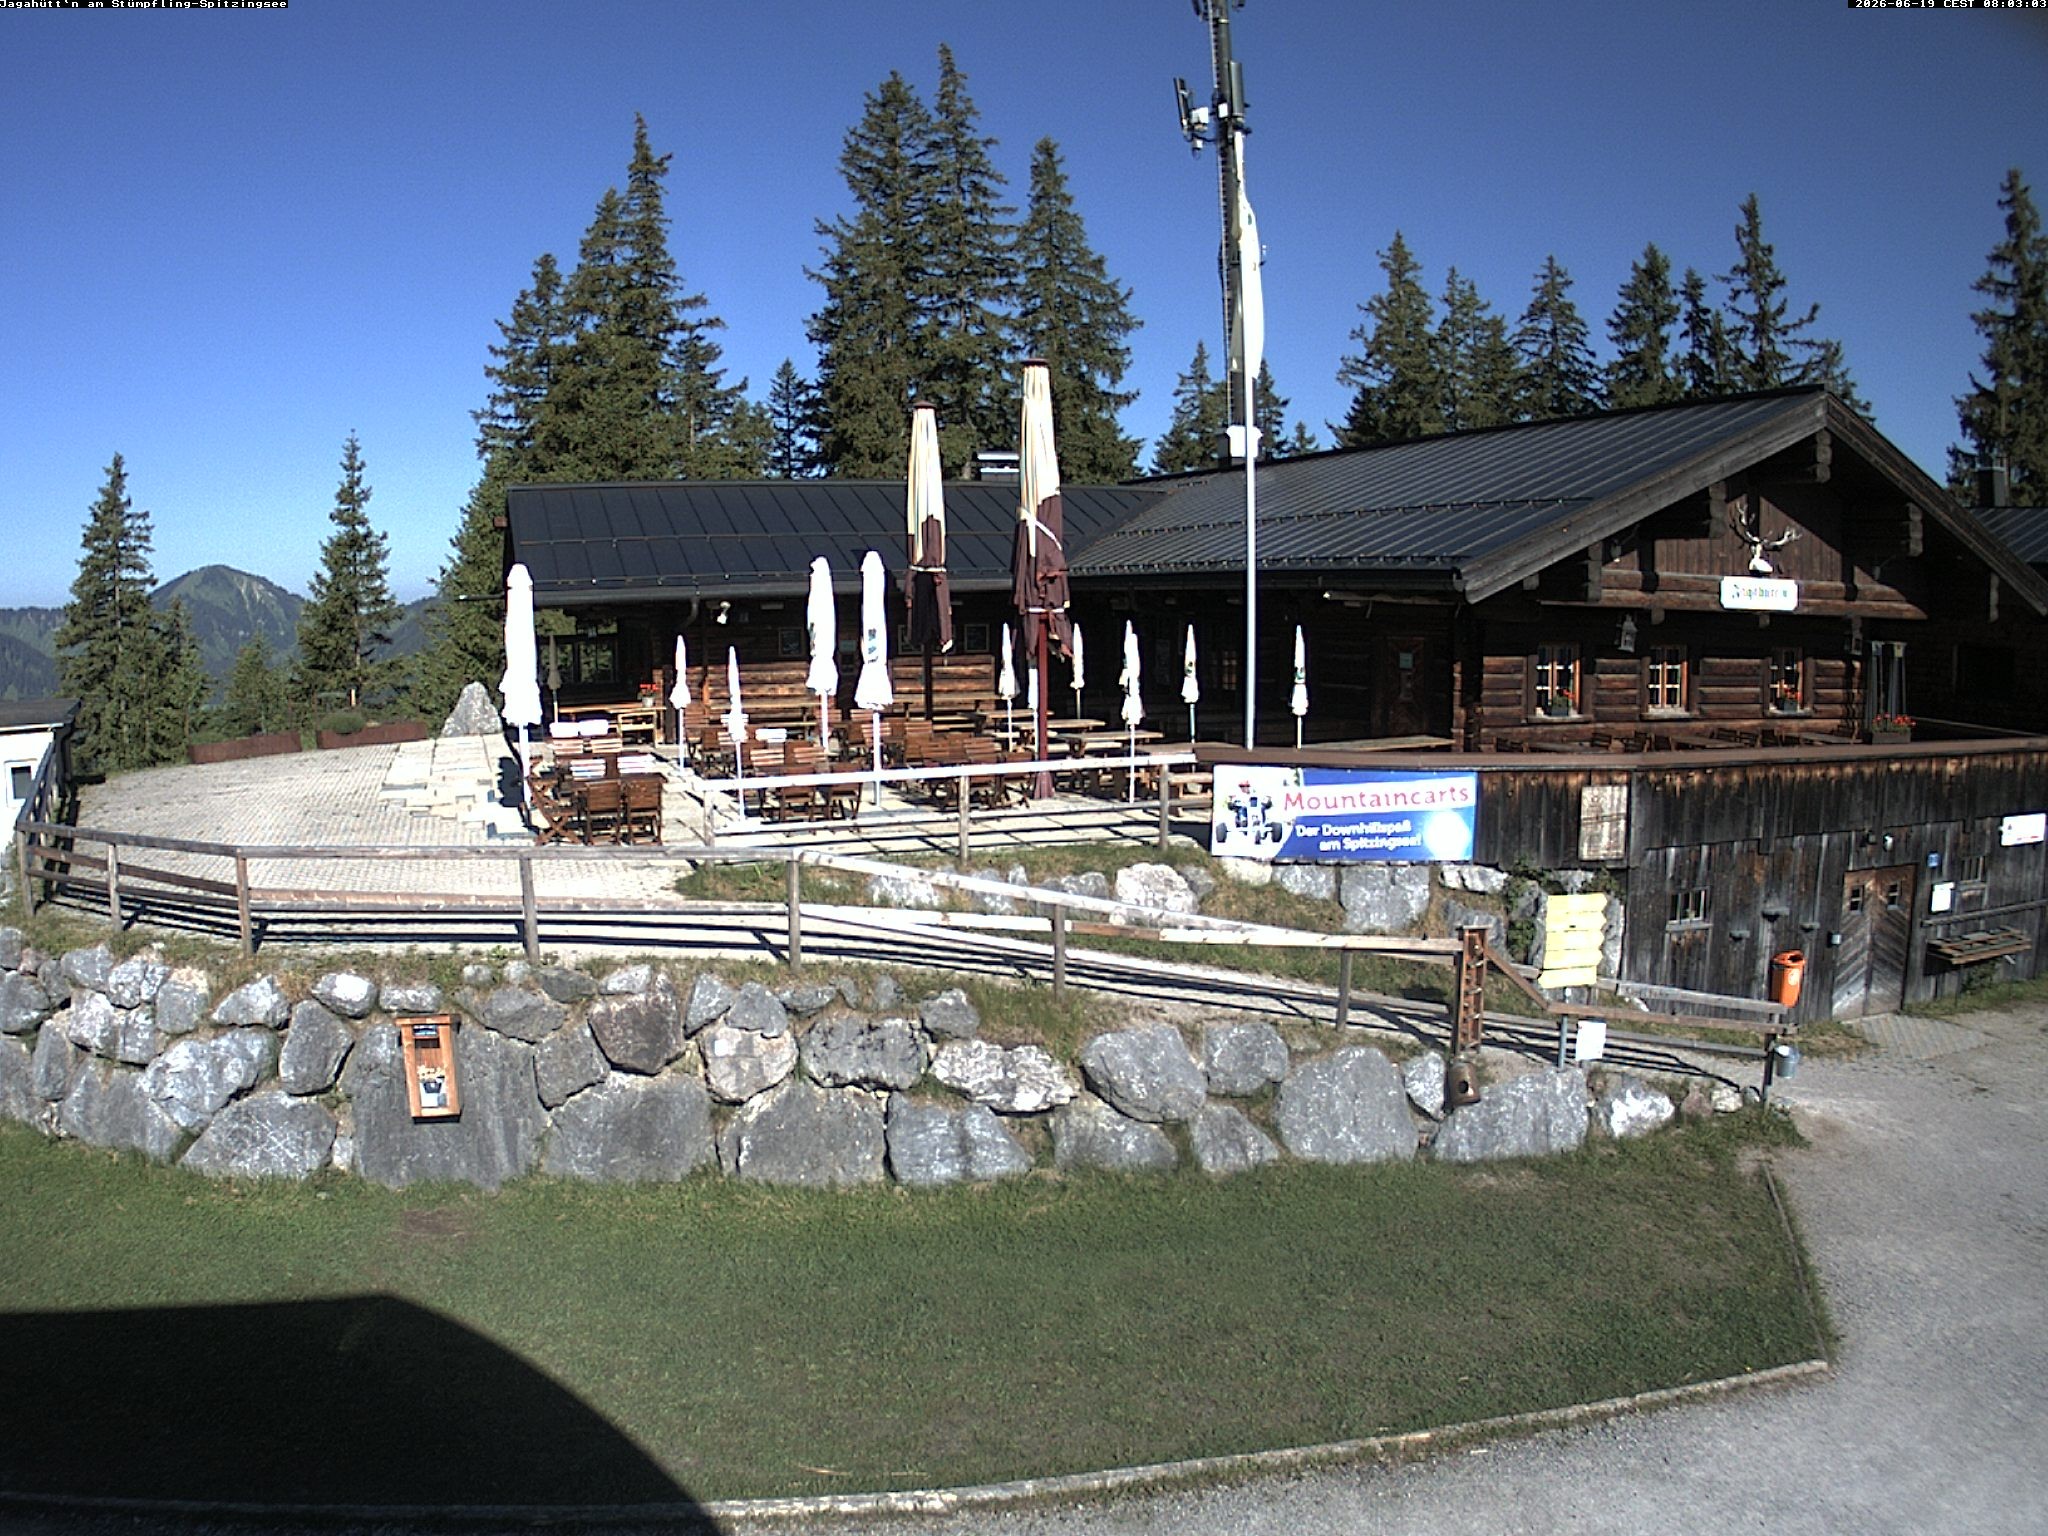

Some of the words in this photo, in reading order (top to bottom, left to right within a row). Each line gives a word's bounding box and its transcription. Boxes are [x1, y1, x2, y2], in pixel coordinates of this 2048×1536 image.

[1284, 786, 1470, 811] Mountaincarts
[1295, 824, 1320, 837] Der
[1319, 840, 1341, 851] am
